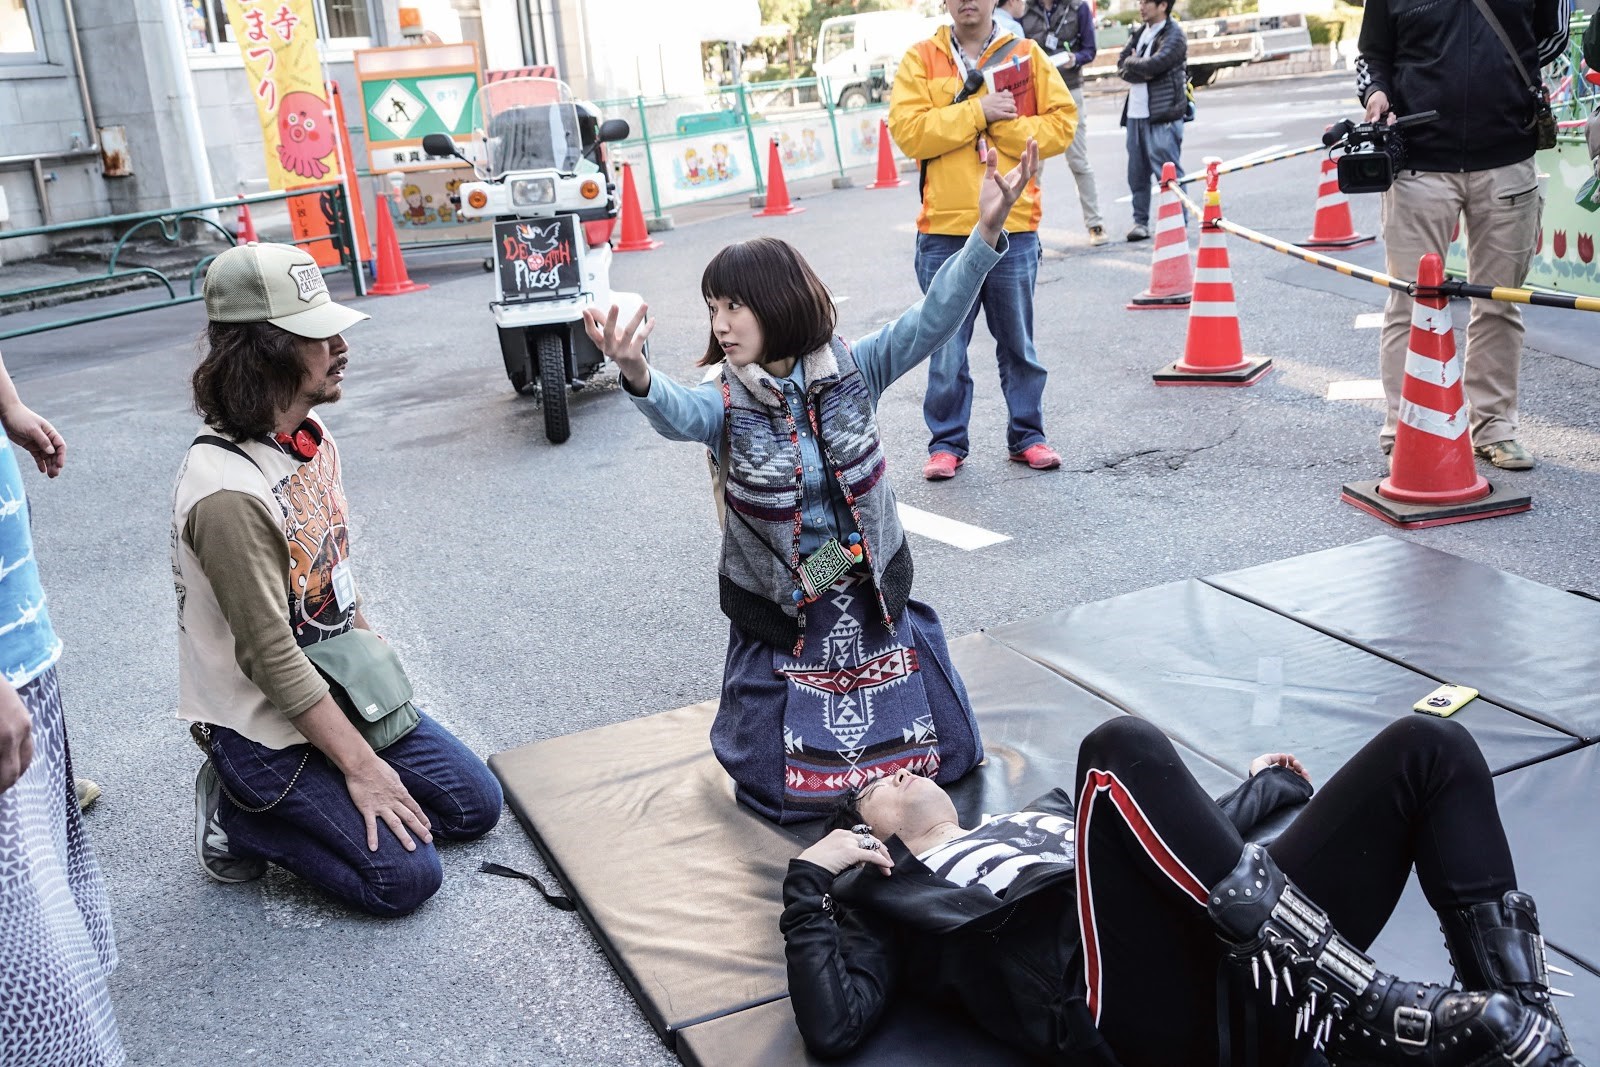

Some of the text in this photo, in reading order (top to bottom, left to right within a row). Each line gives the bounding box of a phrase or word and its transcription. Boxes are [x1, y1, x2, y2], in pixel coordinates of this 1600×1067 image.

[271, 6, 298, 41] 寺
[240, 0, 275, 110] まつり
[502, 235, 571, 272] DEATH
